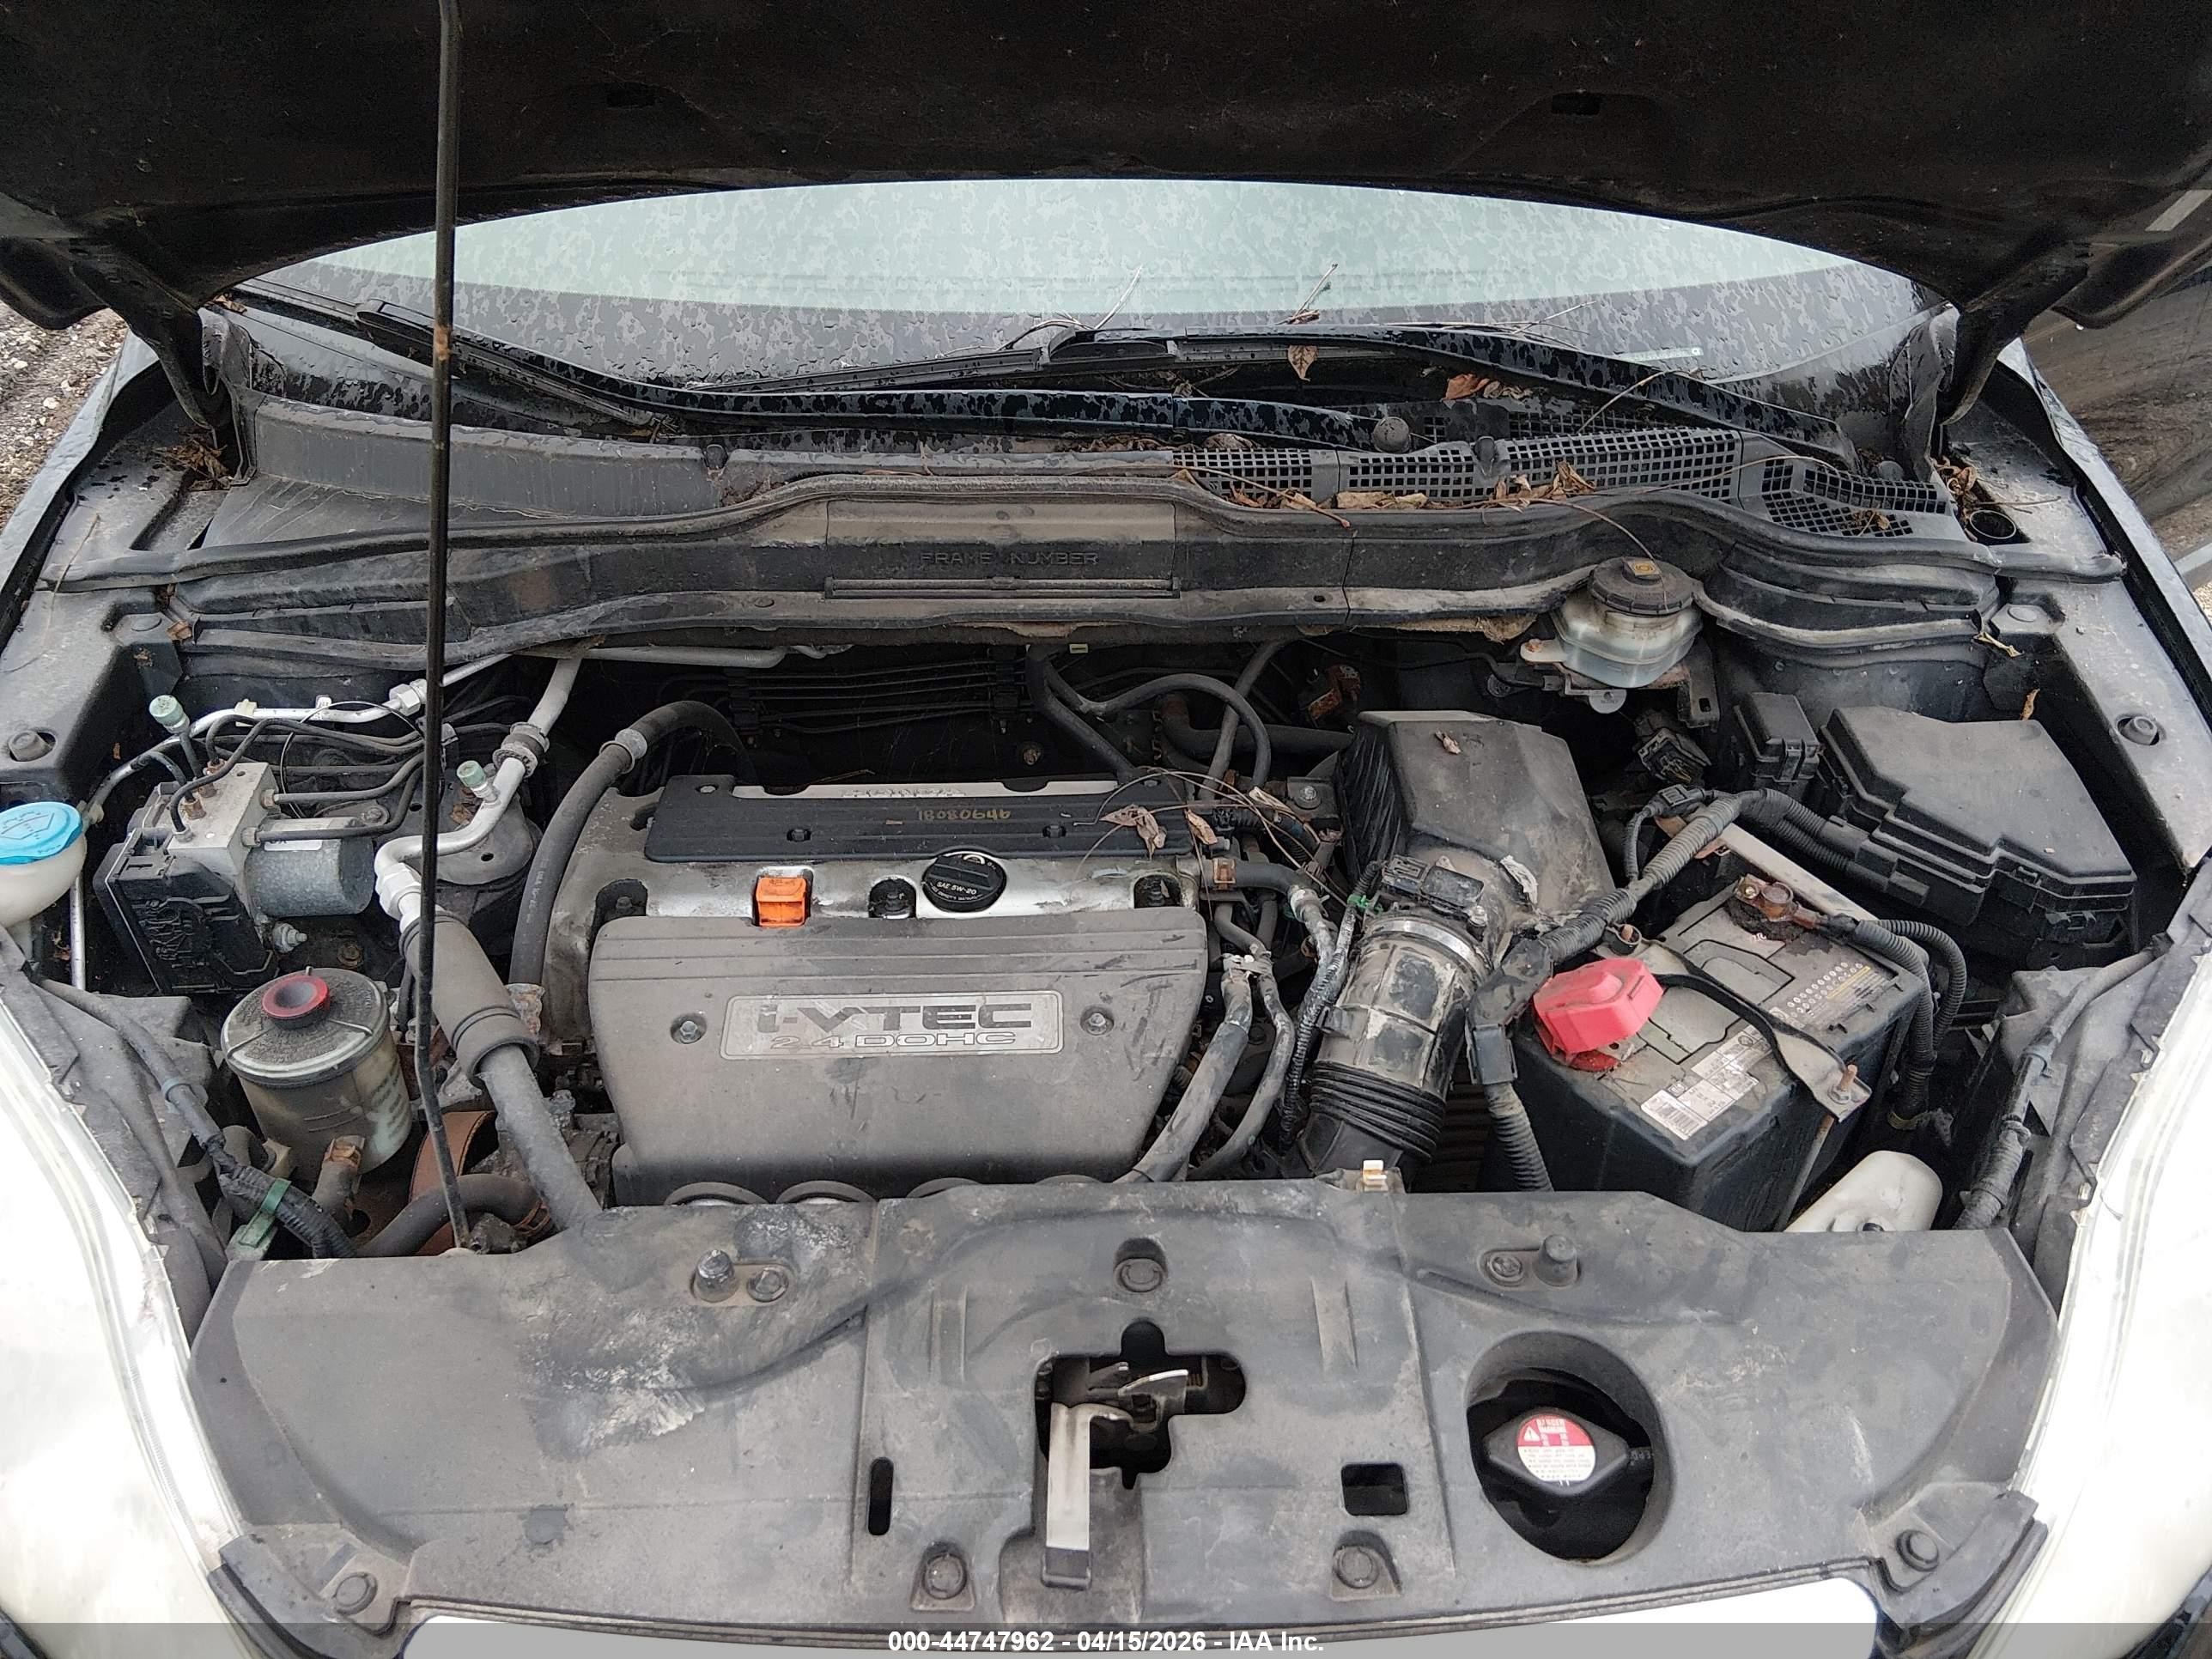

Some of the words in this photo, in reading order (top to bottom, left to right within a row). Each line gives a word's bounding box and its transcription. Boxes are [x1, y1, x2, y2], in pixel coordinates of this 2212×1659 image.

[920, 552, 993, 565] FRAME
[1010, 552, 1099, 565] NUMBER
[937, 881, 951, 890] SAE
[951, 884, 977, 896] 5W-20
[769, 1035, 845, 1049] 2.4
[854, 1031, 1017, 1048] DOHC
